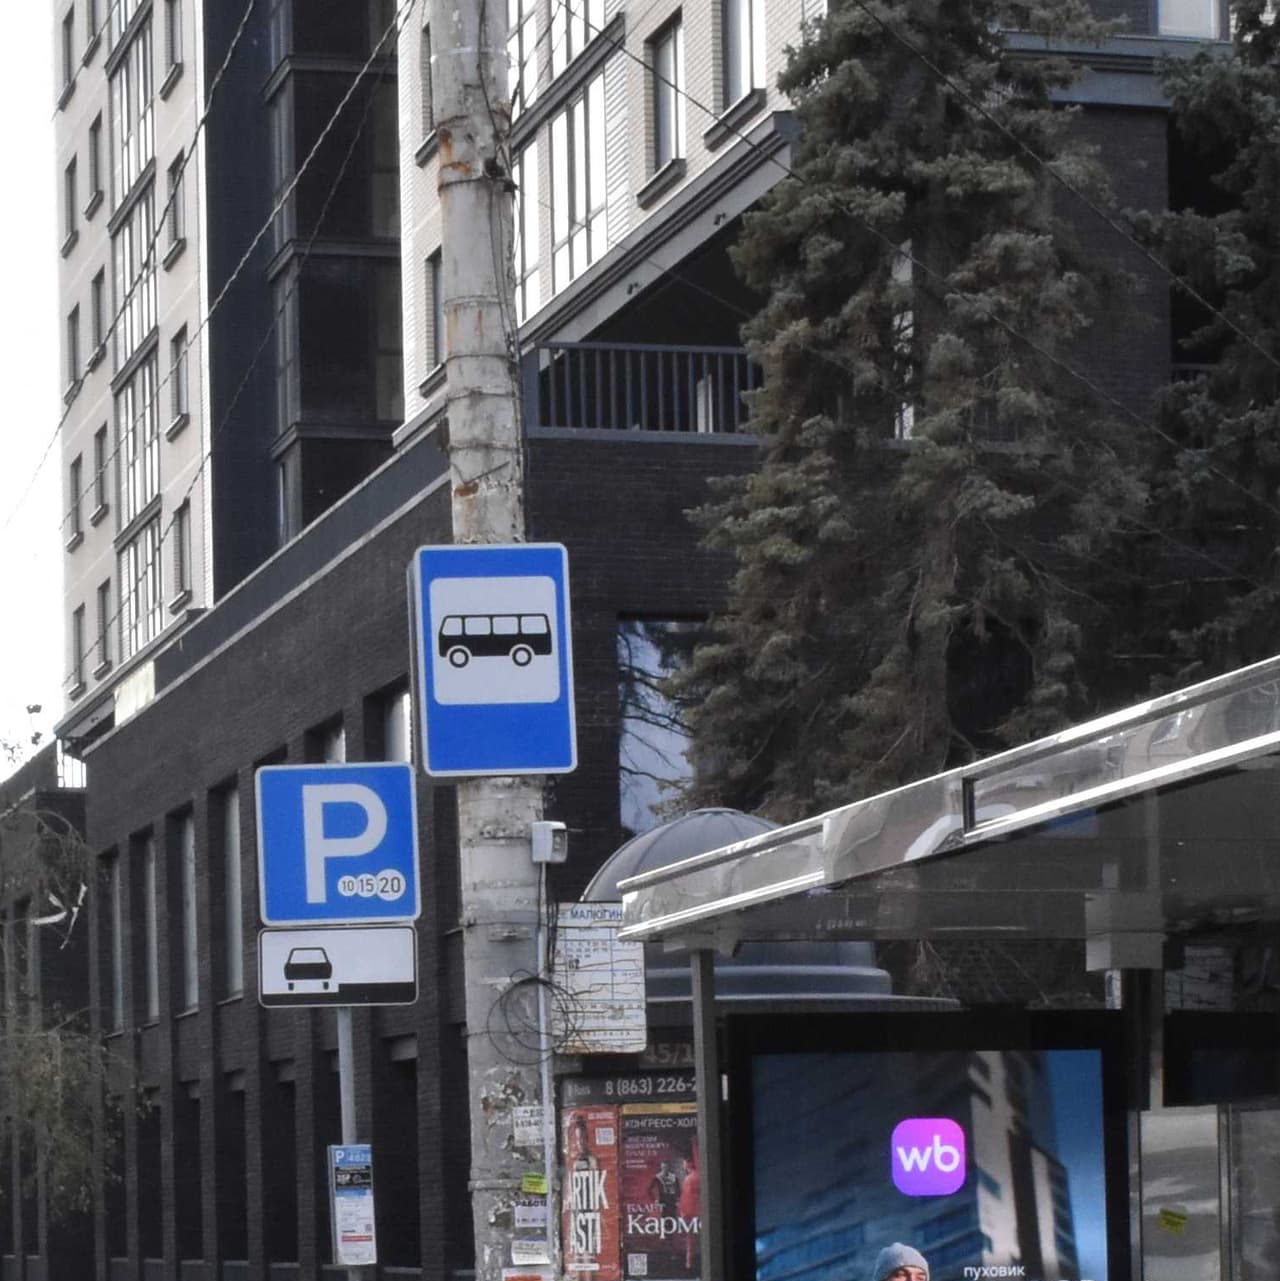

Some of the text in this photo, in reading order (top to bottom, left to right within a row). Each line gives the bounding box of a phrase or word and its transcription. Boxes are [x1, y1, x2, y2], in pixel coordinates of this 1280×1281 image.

[302, 784, 388, 904] P
[342, 876, 401, 893] 10 15 20
[571, 908, 624, 920] МАЛЮГИН
[617, 1078, 654, 1096] (863)
[897, 1135, 960, 1172] wb
[963, 1266, 1025, 1281] пуховик
